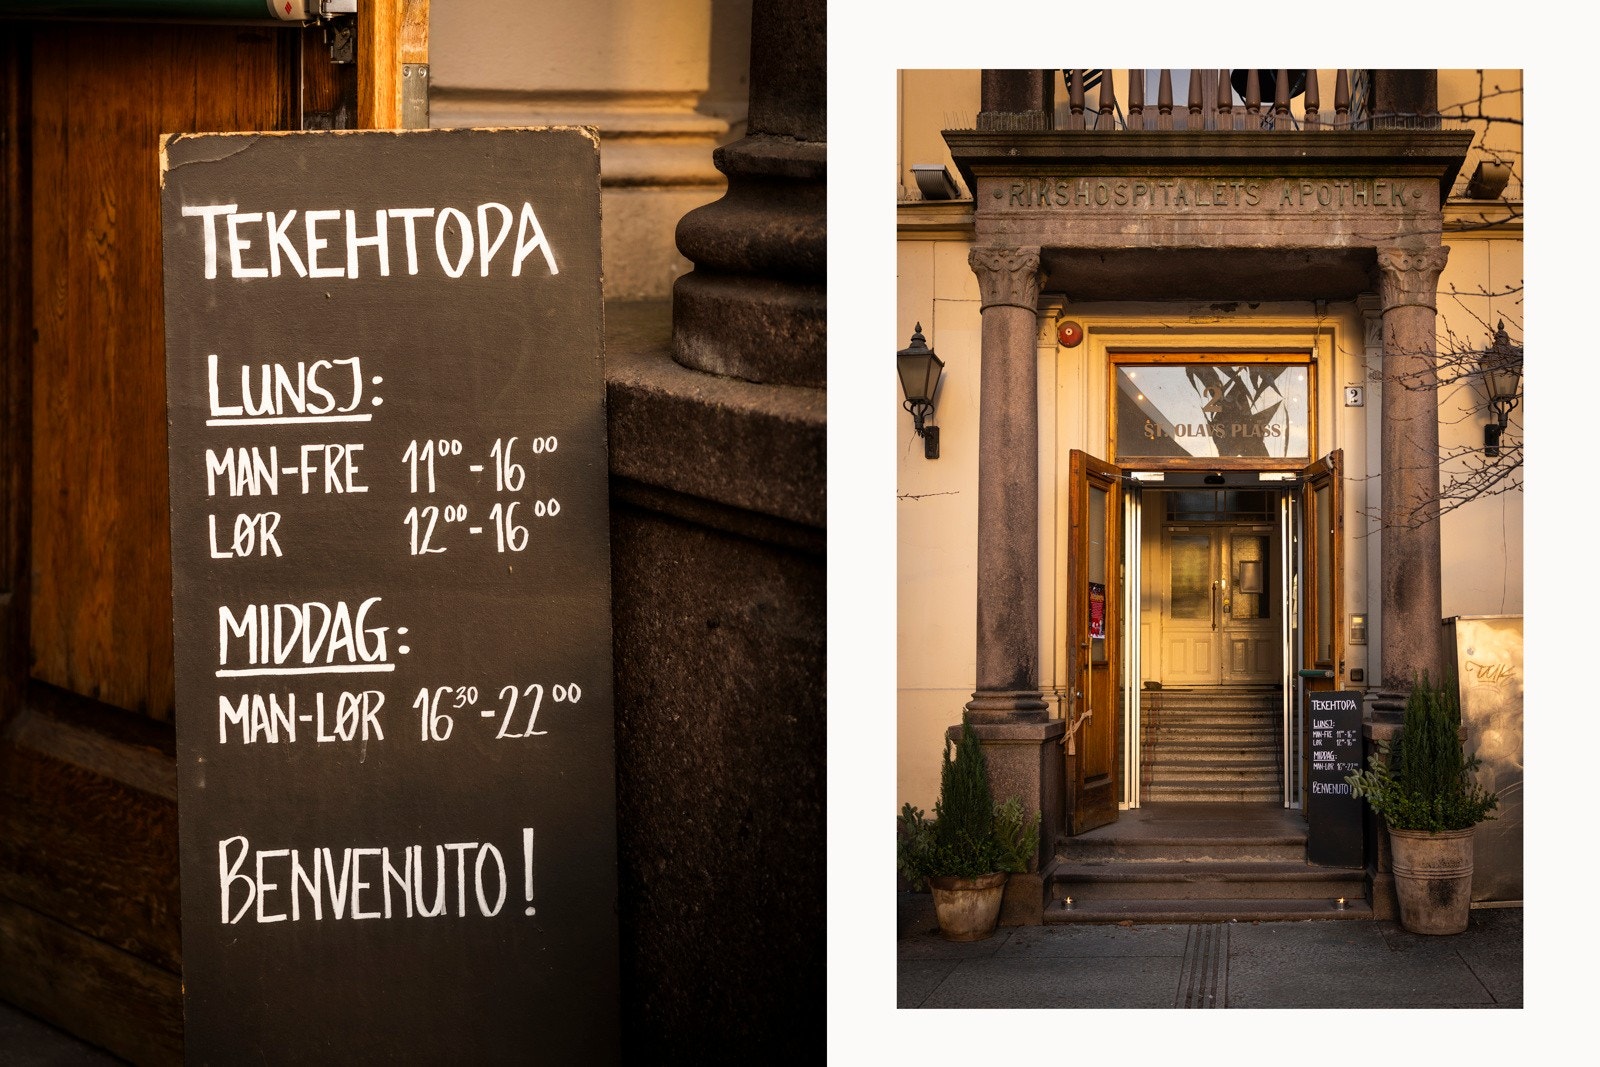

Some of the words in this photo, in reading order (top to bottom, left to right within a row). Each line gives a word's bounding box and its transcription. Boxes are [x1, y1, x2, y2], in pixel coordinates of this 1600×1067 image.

[1008, 182, 1261, 207] RIKSHOSPITALETS
[1279, 182, 1407, 207] APOTHEK
[181, 201, 560, 280] TEKEHTOPA
[205, 354, 383, 426] LUNSJ:
[1349, 389, 1359, 403] 2
[1231, 423, 1281, 438] PLASS
[205, 443, 369, 496] MAN-FRE
[208, 511, 283, 558] LØR
[215, 597, 411, 677] MIDDAG:
[219, 690, 385, 744] MAN-LØR
[1311, 700, 1357, 710] TEKEHTOPA
